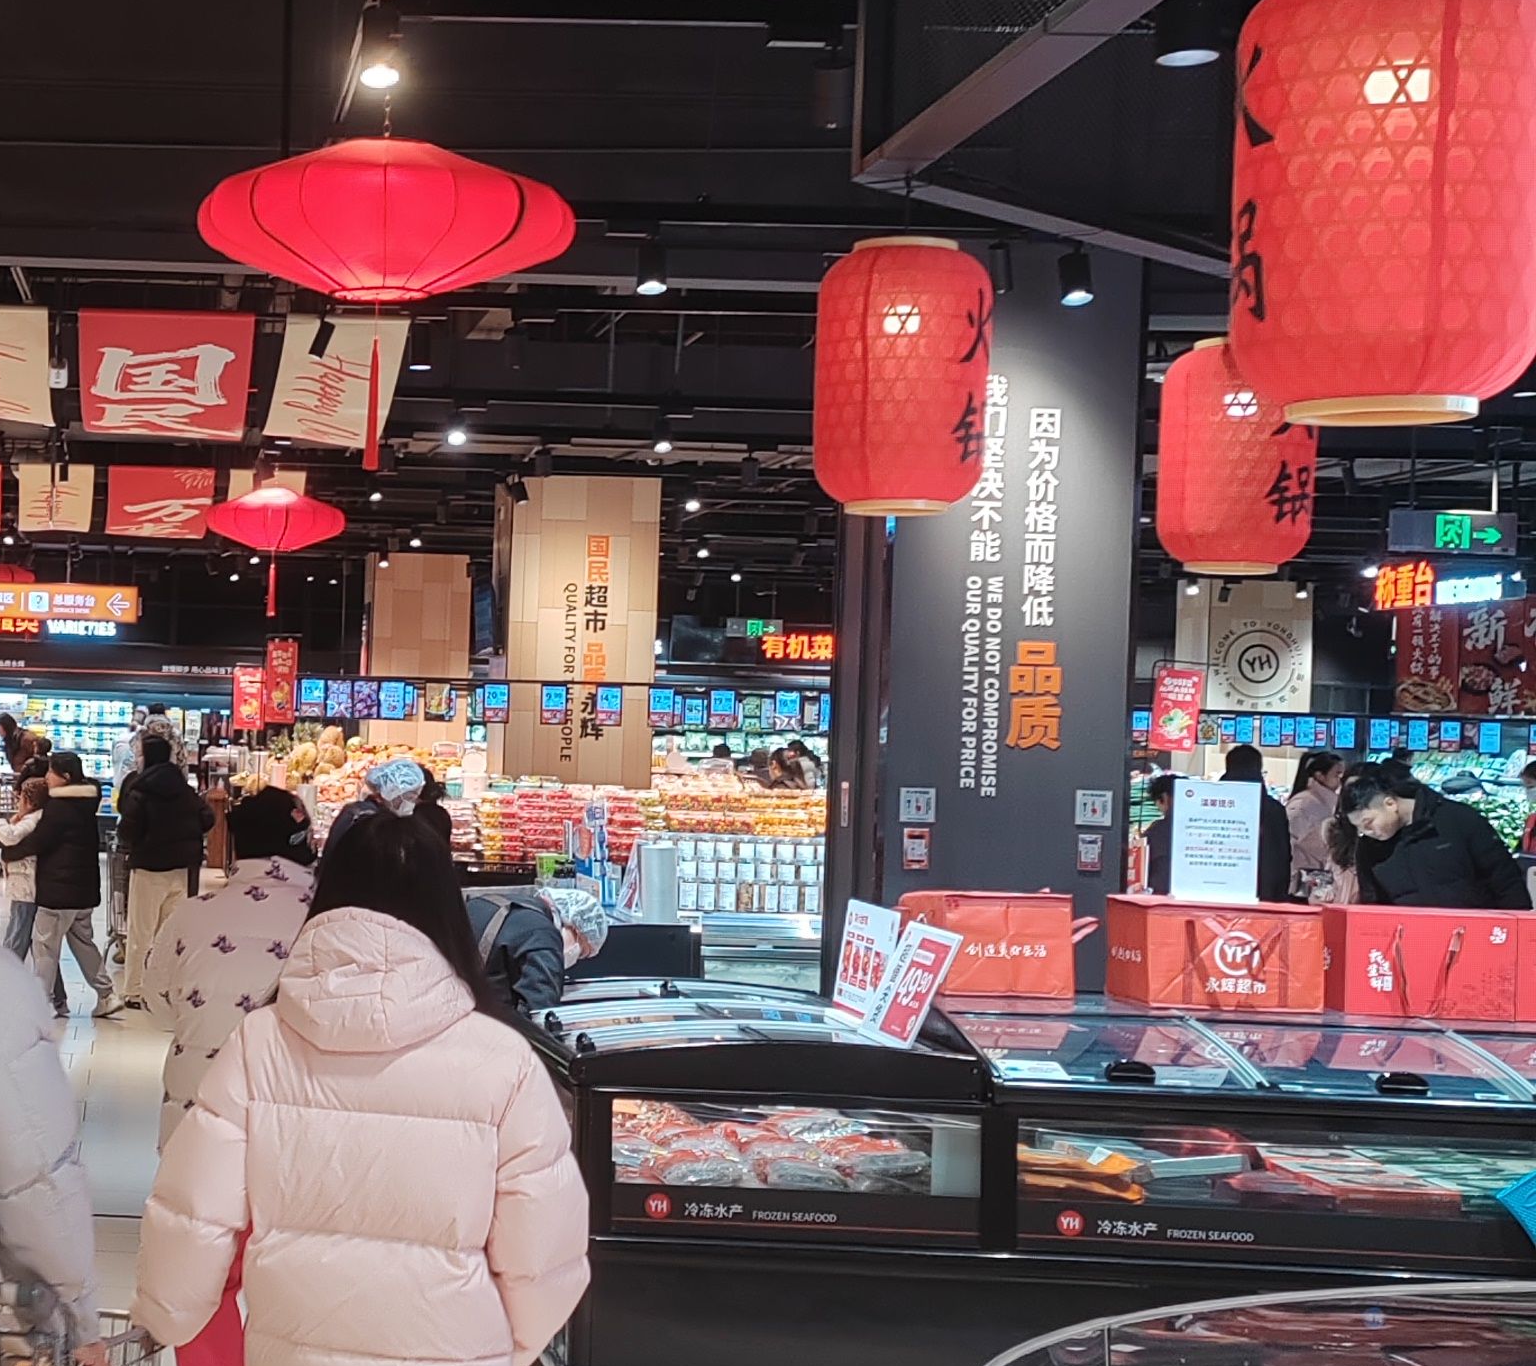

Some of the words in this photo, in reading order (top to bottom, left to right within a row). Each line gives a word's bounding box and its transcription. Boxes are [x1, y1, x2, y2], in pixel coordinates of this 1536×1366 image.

[1020, 407, 1063, 627] 因为价格而降低
[583, 535, 610, 633] 国民超市
[965, 576, 982, 615] OUR
[987, 576, 1004, 604] WE
[1375, 561, 1435, 611] 称重台
[46, 618, 117, 637] VARIETIES
[563, 583, 578, 646] QUALITY
[986, 608, 1002, 634] DO
[563, 646, 576, 674] FOR
[761, 634, 834, 660] 有机菜
[961, 618, 981, 695] QUALITY
[984, 637, 1001, 675] NOT
[1244, 654, 1272, 674] YH
[1005, 640, 1063, 753] 品质
[961, 698, 978, 733] FOR
[980, 676, 1000, 798] COMPROMISE
[960, 735, 977, 789] PRICE
[1205, 976, 1268, 994] 永辉超市
[649, 1200, 667, 1213] YH
[684, 1201, 744, 1219] 冷冻水产
[752, 1209, 790, 1222] FROZEN
[792, 1211, 837, 1223] SEAFOOD
[1061, 1216, 1080, 1230] YH
[1097, 1219, 1158, 1237] 冷冻水产
[1166, 1228, 1206, 1241] FROZEN
[1208, 1230, 1255, 1243] SEAFOOD
